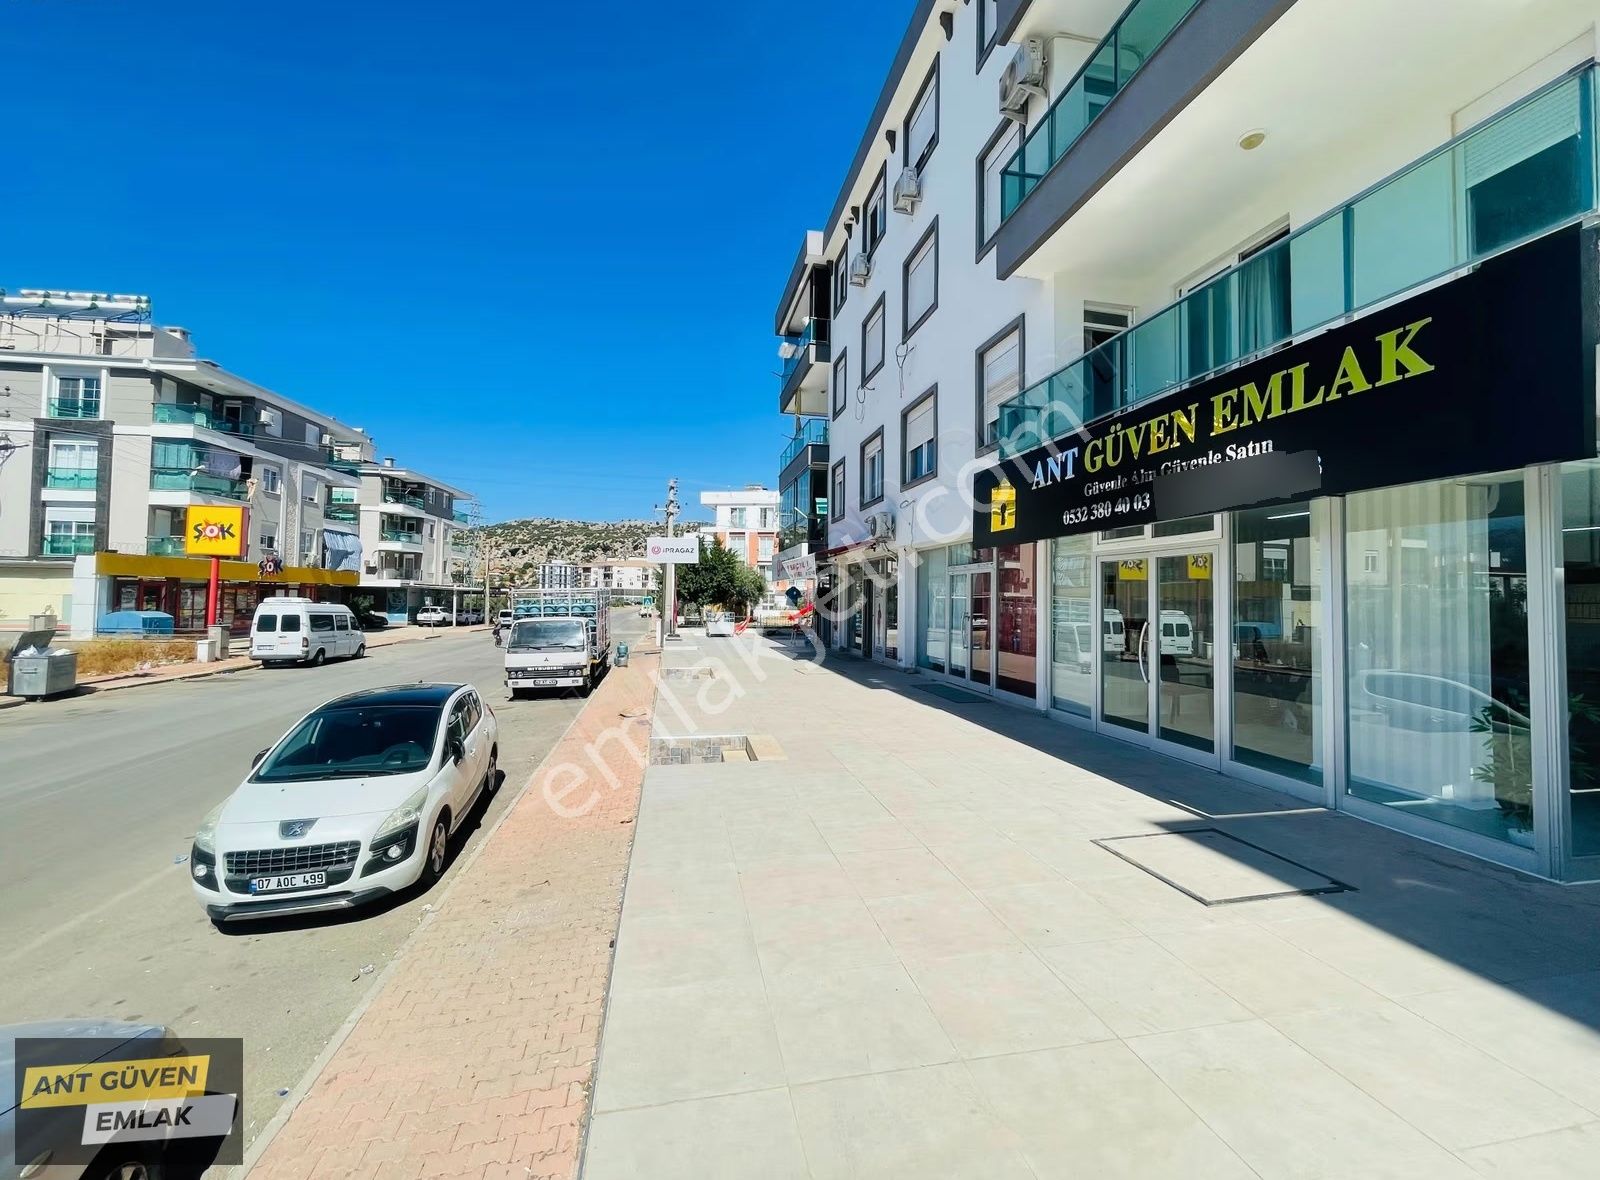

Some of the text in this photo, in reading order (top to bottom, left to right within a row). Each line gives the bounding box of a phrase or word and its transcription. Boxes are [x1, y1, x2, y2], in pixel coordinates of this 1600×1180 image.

[1031, 316, 1435, 490] ANT GÜVEN EMLAK
[1084, 476, 1128, 498] Güvenle
[1160, 450, 1222, 477] Güvenle
[1225, 439, 1274, 463] Satın
[1063, 492, 1150, 526] 0532 380 40 03
[193, 522, 236, 544] ŞOK
[257, 873, 324, 890] 07 AOC 499
